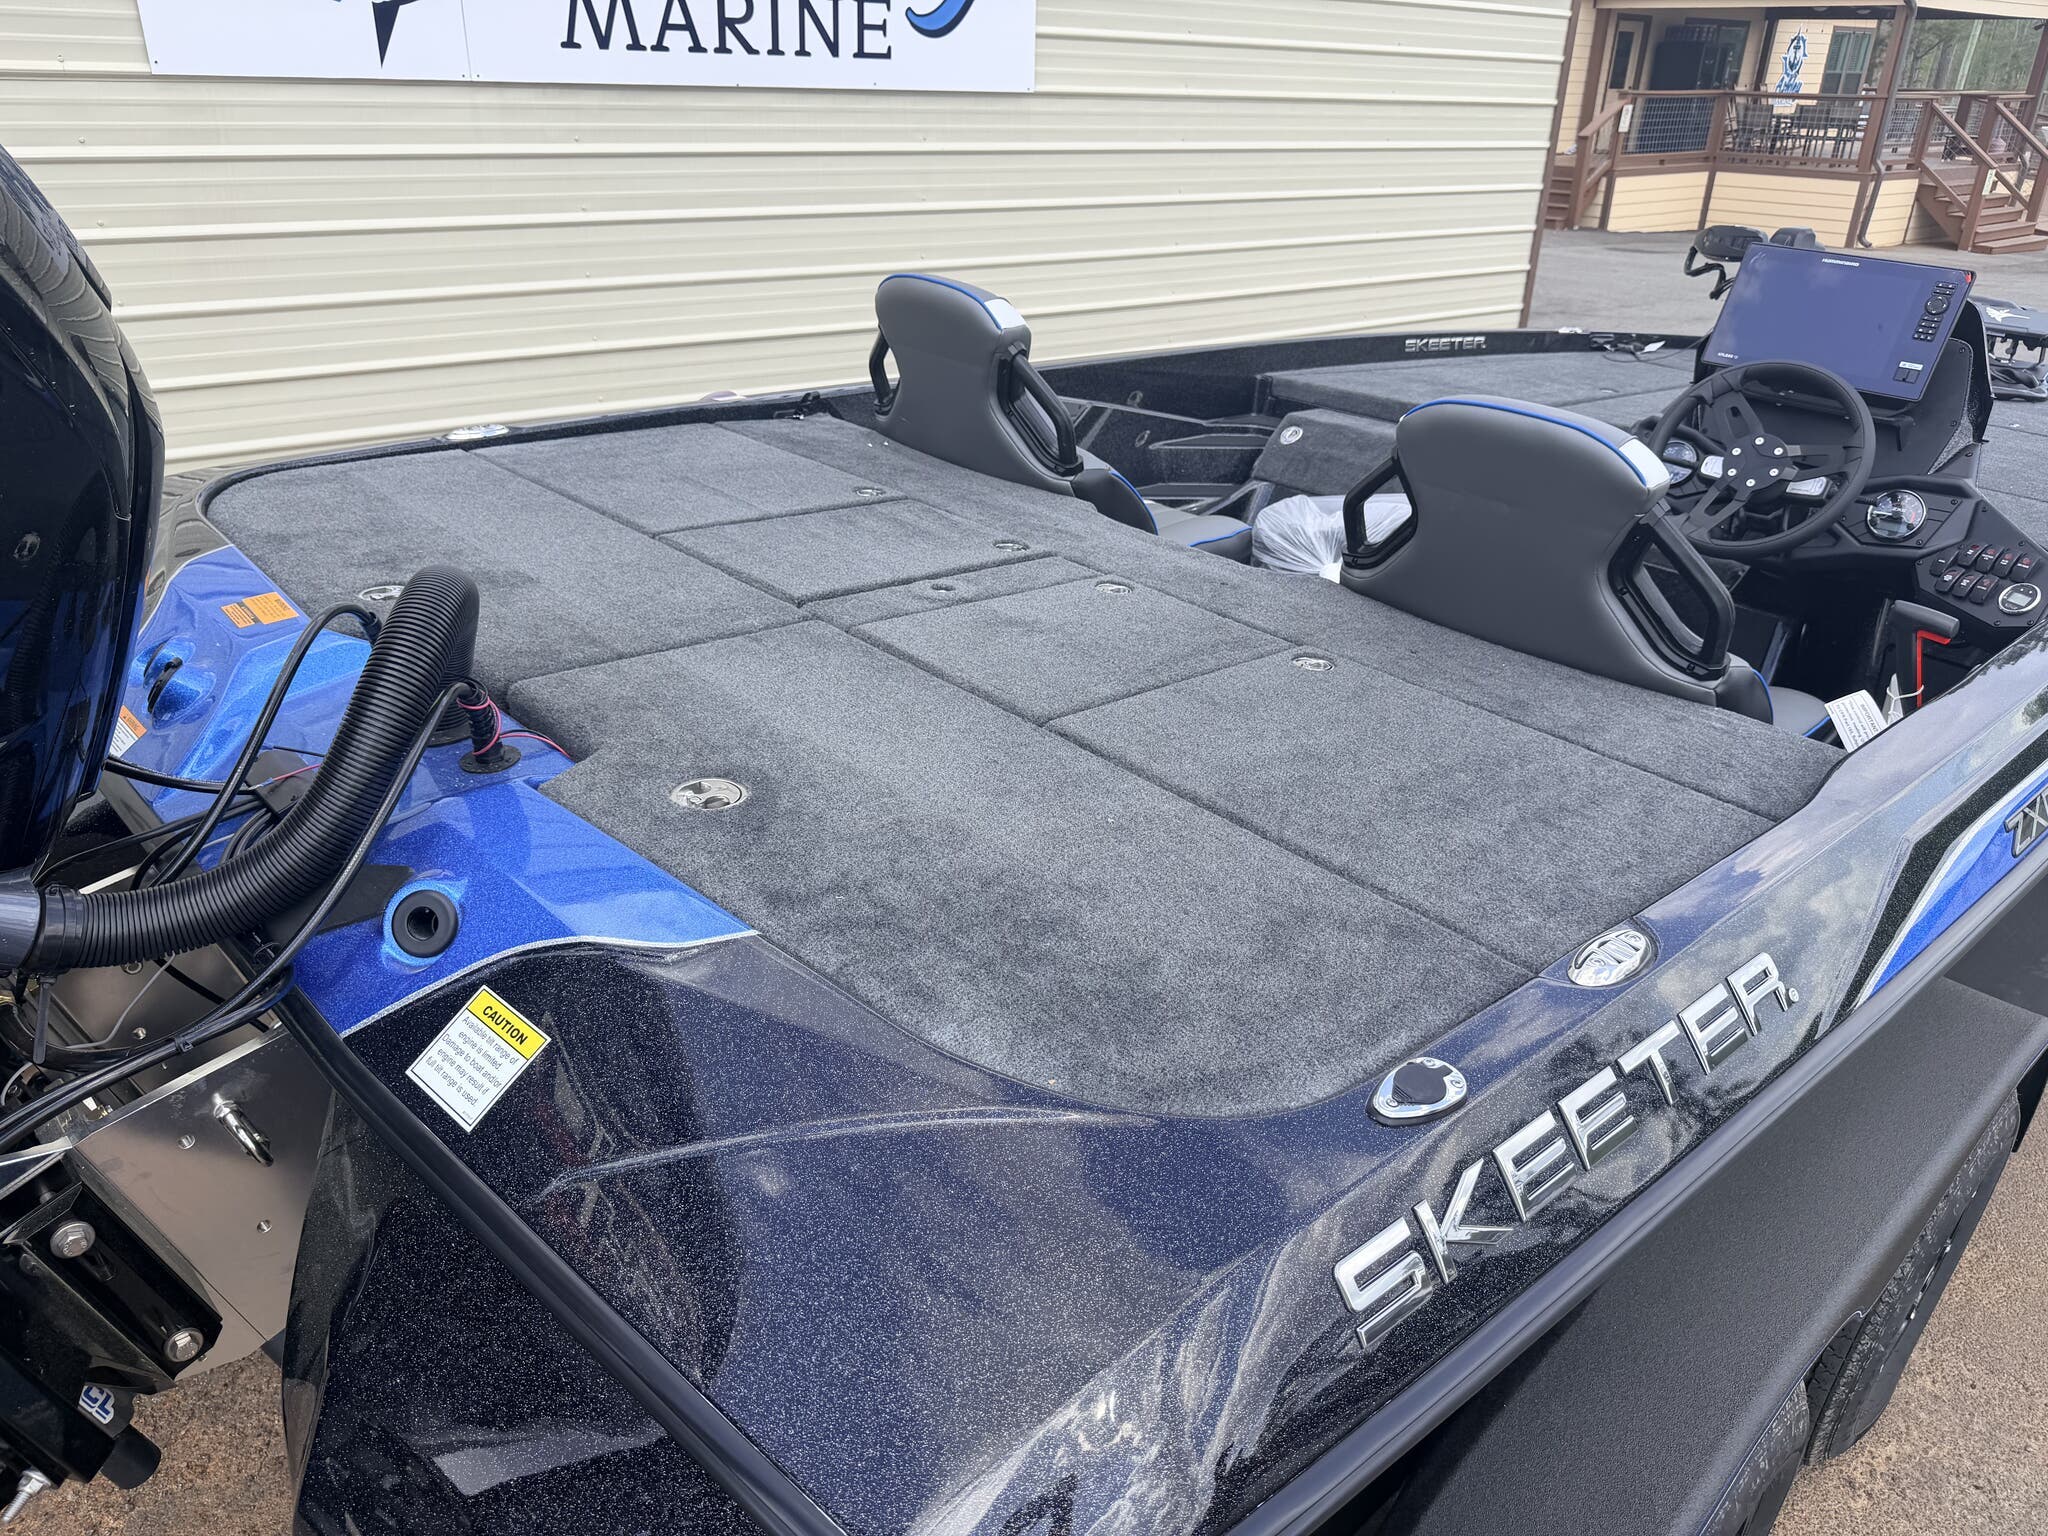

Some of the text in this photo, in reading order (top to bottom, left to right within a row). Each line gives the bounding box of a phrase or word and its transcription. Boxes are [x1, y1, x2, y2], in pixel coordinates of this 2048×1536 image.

[560, 0, 892, 59] MARINE
[1404, 336, 1487, 353] SKEETER
[462, 1016, 520, 1065] Available tilt range of
[483, 1006, 528, 1045] CAUTION
[425, 1055, 437, 1068] full
[434, 1063, 444, 1074] tilt
[440, 1071, 458, 1088] range
[455, 1083, 464, 1093] is
[437, 1048, 490, 1095] engine may result if
[442, 1033, 502, 1088] Damage to boat and/or
[458, 1031, 503, 1071] engine is limited.
[1333, 951, 1799, 1351] SKEETER
